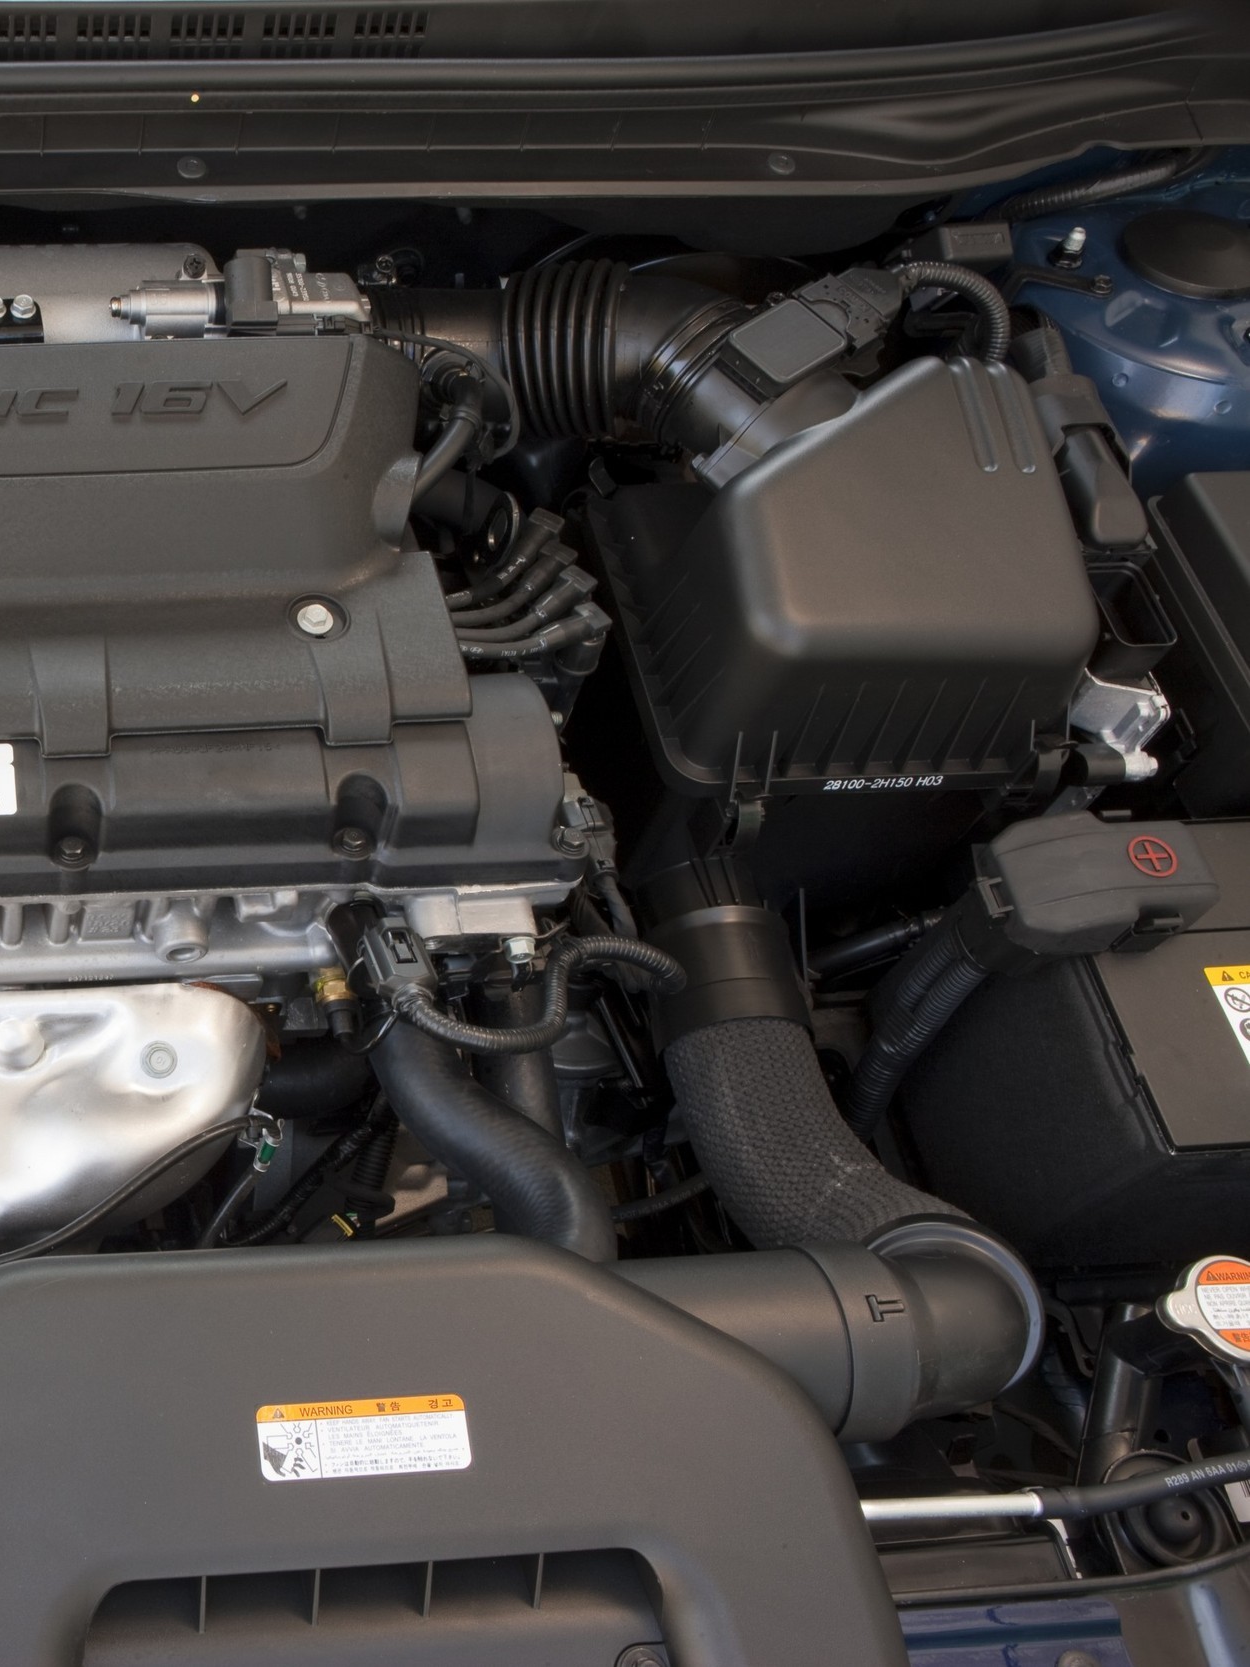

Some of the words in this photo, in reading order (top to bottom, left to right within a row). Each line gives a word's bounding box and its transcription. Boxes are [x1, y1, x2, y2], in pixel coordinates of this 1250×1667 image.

[110, 377, 289, 418] 16V
[823, 777, 914, 791] 28100-2H150
[915, 775, 944, 787] H03
[299, 1405, 353, 1417] WARNING
[428, 1398, 454, 1409] 경고
[1165, 1473, 1189, 1487] R289
[1191, 1469, 1205, 1480] AN
